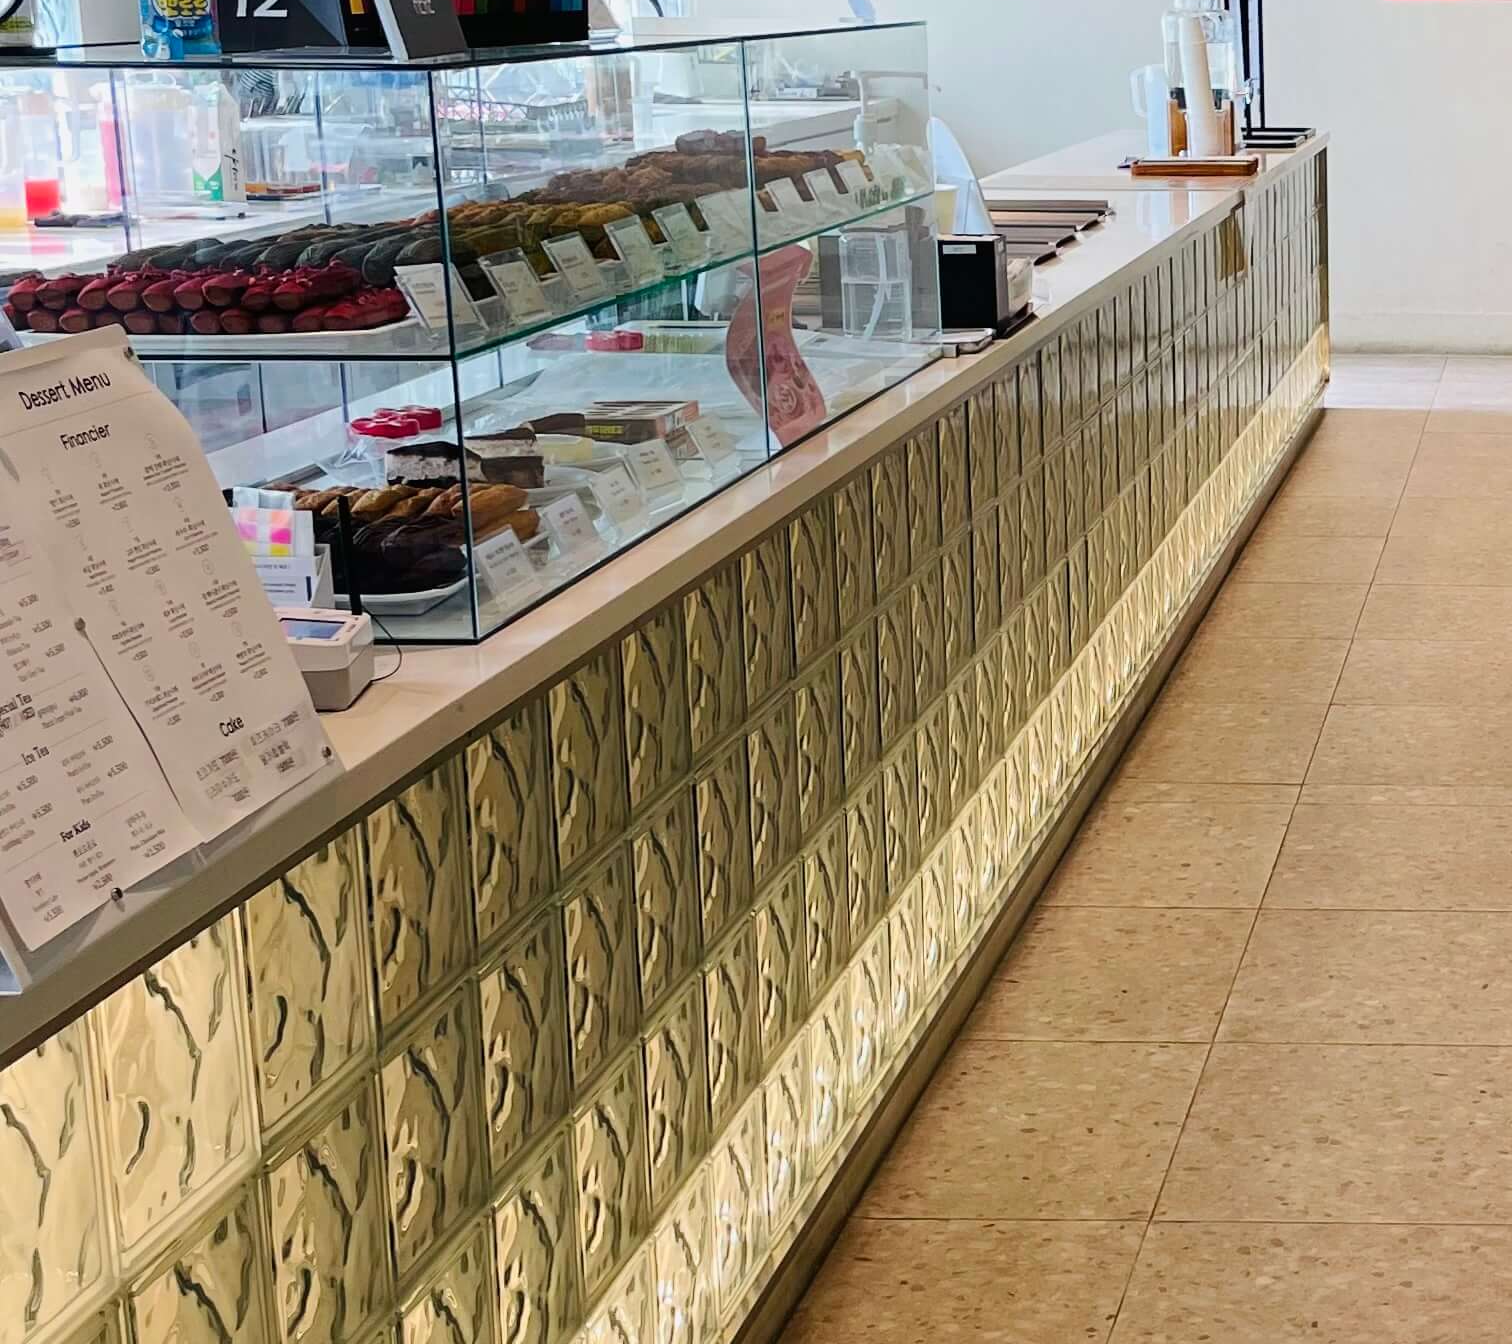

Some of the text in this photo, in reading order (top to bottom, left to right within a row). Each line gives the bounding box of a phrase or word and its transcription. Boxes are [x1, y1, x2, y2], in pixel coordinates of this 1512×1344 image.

[18, 371, 112, 411] Dessert Menu
[60, 423, 111, 451] Financier
[219, 715, 245, 737] Cake
[60, 819, 92, 843] For Kids
